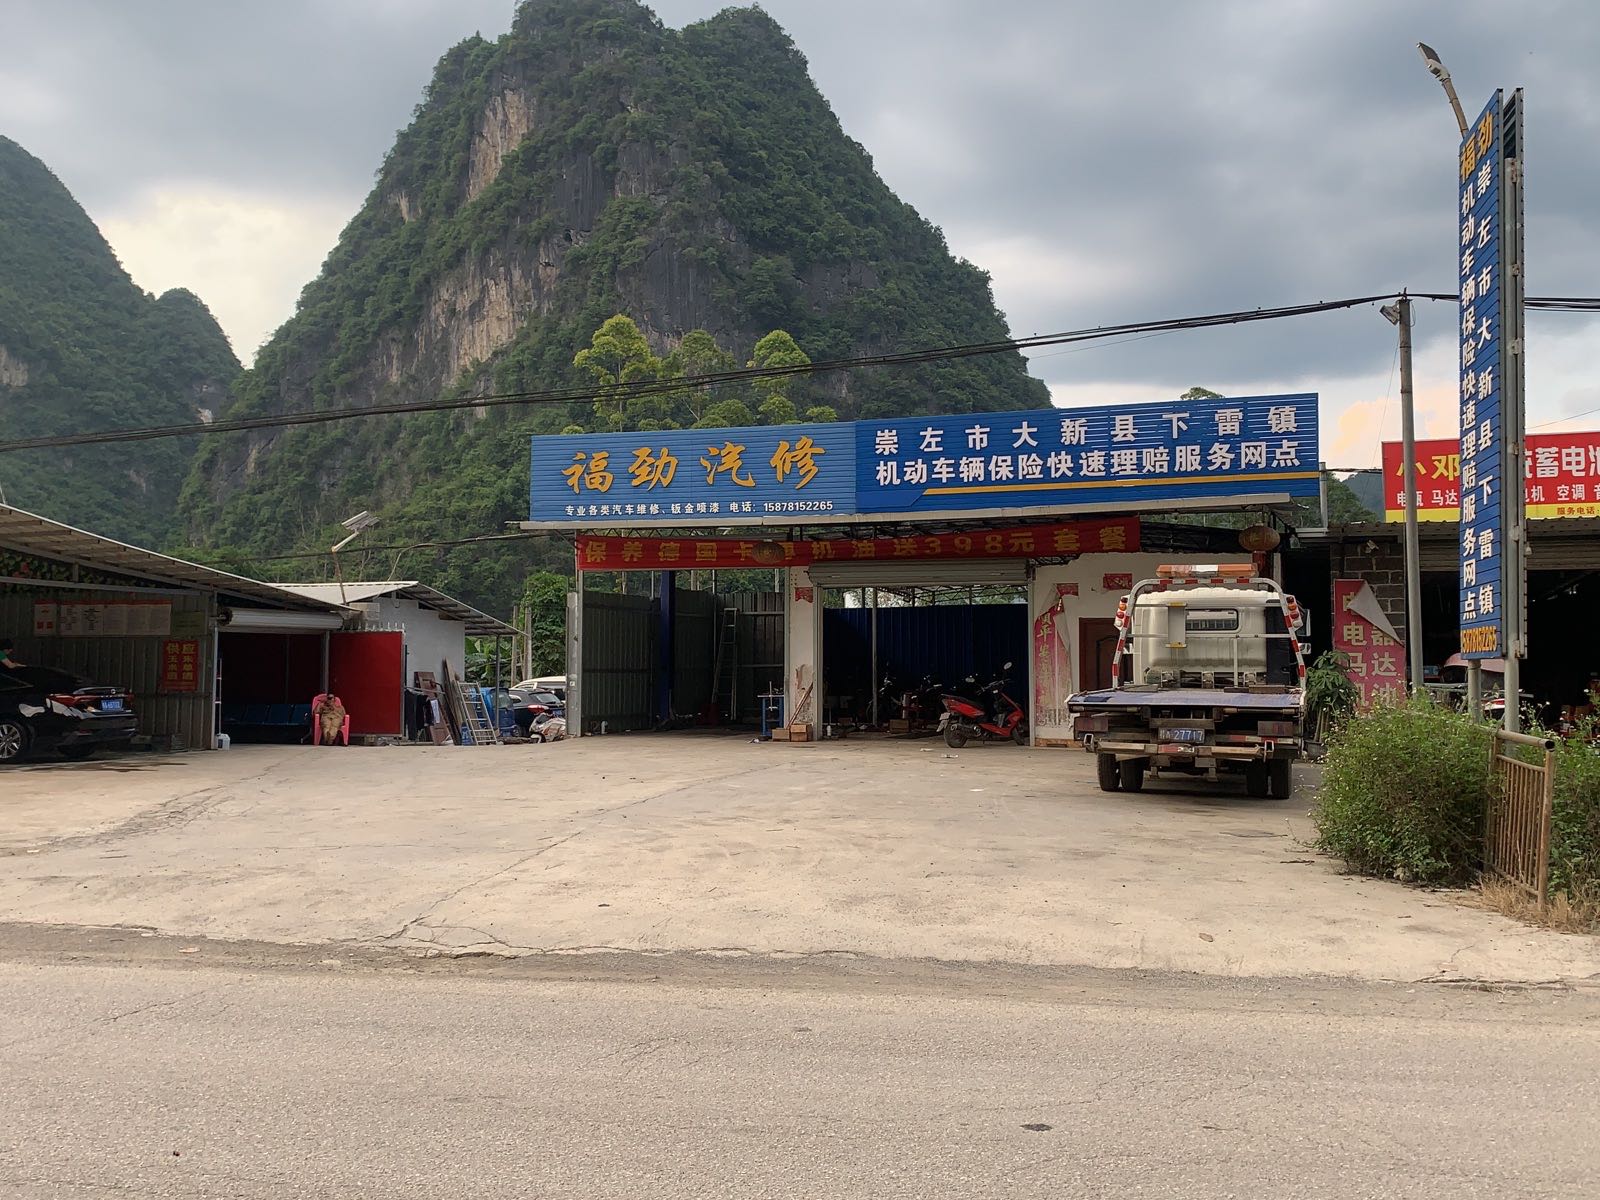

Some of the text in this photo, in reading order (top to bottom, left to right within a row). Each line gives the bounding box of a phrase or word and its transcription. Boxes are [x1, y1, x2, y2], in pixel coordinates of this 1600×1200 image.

[1461, 182, 1476, 620] 机动车辆保险快速理赔服务网点
[1477, 160, 1493, 615] 崇左市大新县下雷镇
[875, 405, 1298, 456] 崇左市大新县下雷镇
[561, 435, 826, 495] 福劲汽修
[875, 439, 1300, 487] 机动车辆保险快速理赔服务网点
[565, 502, 719, 516] 专业各类汽车维修、钣金喷漆
[763, 501, 833, 512] 15878152265
[1432, 490, 1458, 506] 马达
[1557, 484, 1585, 501] 空调
